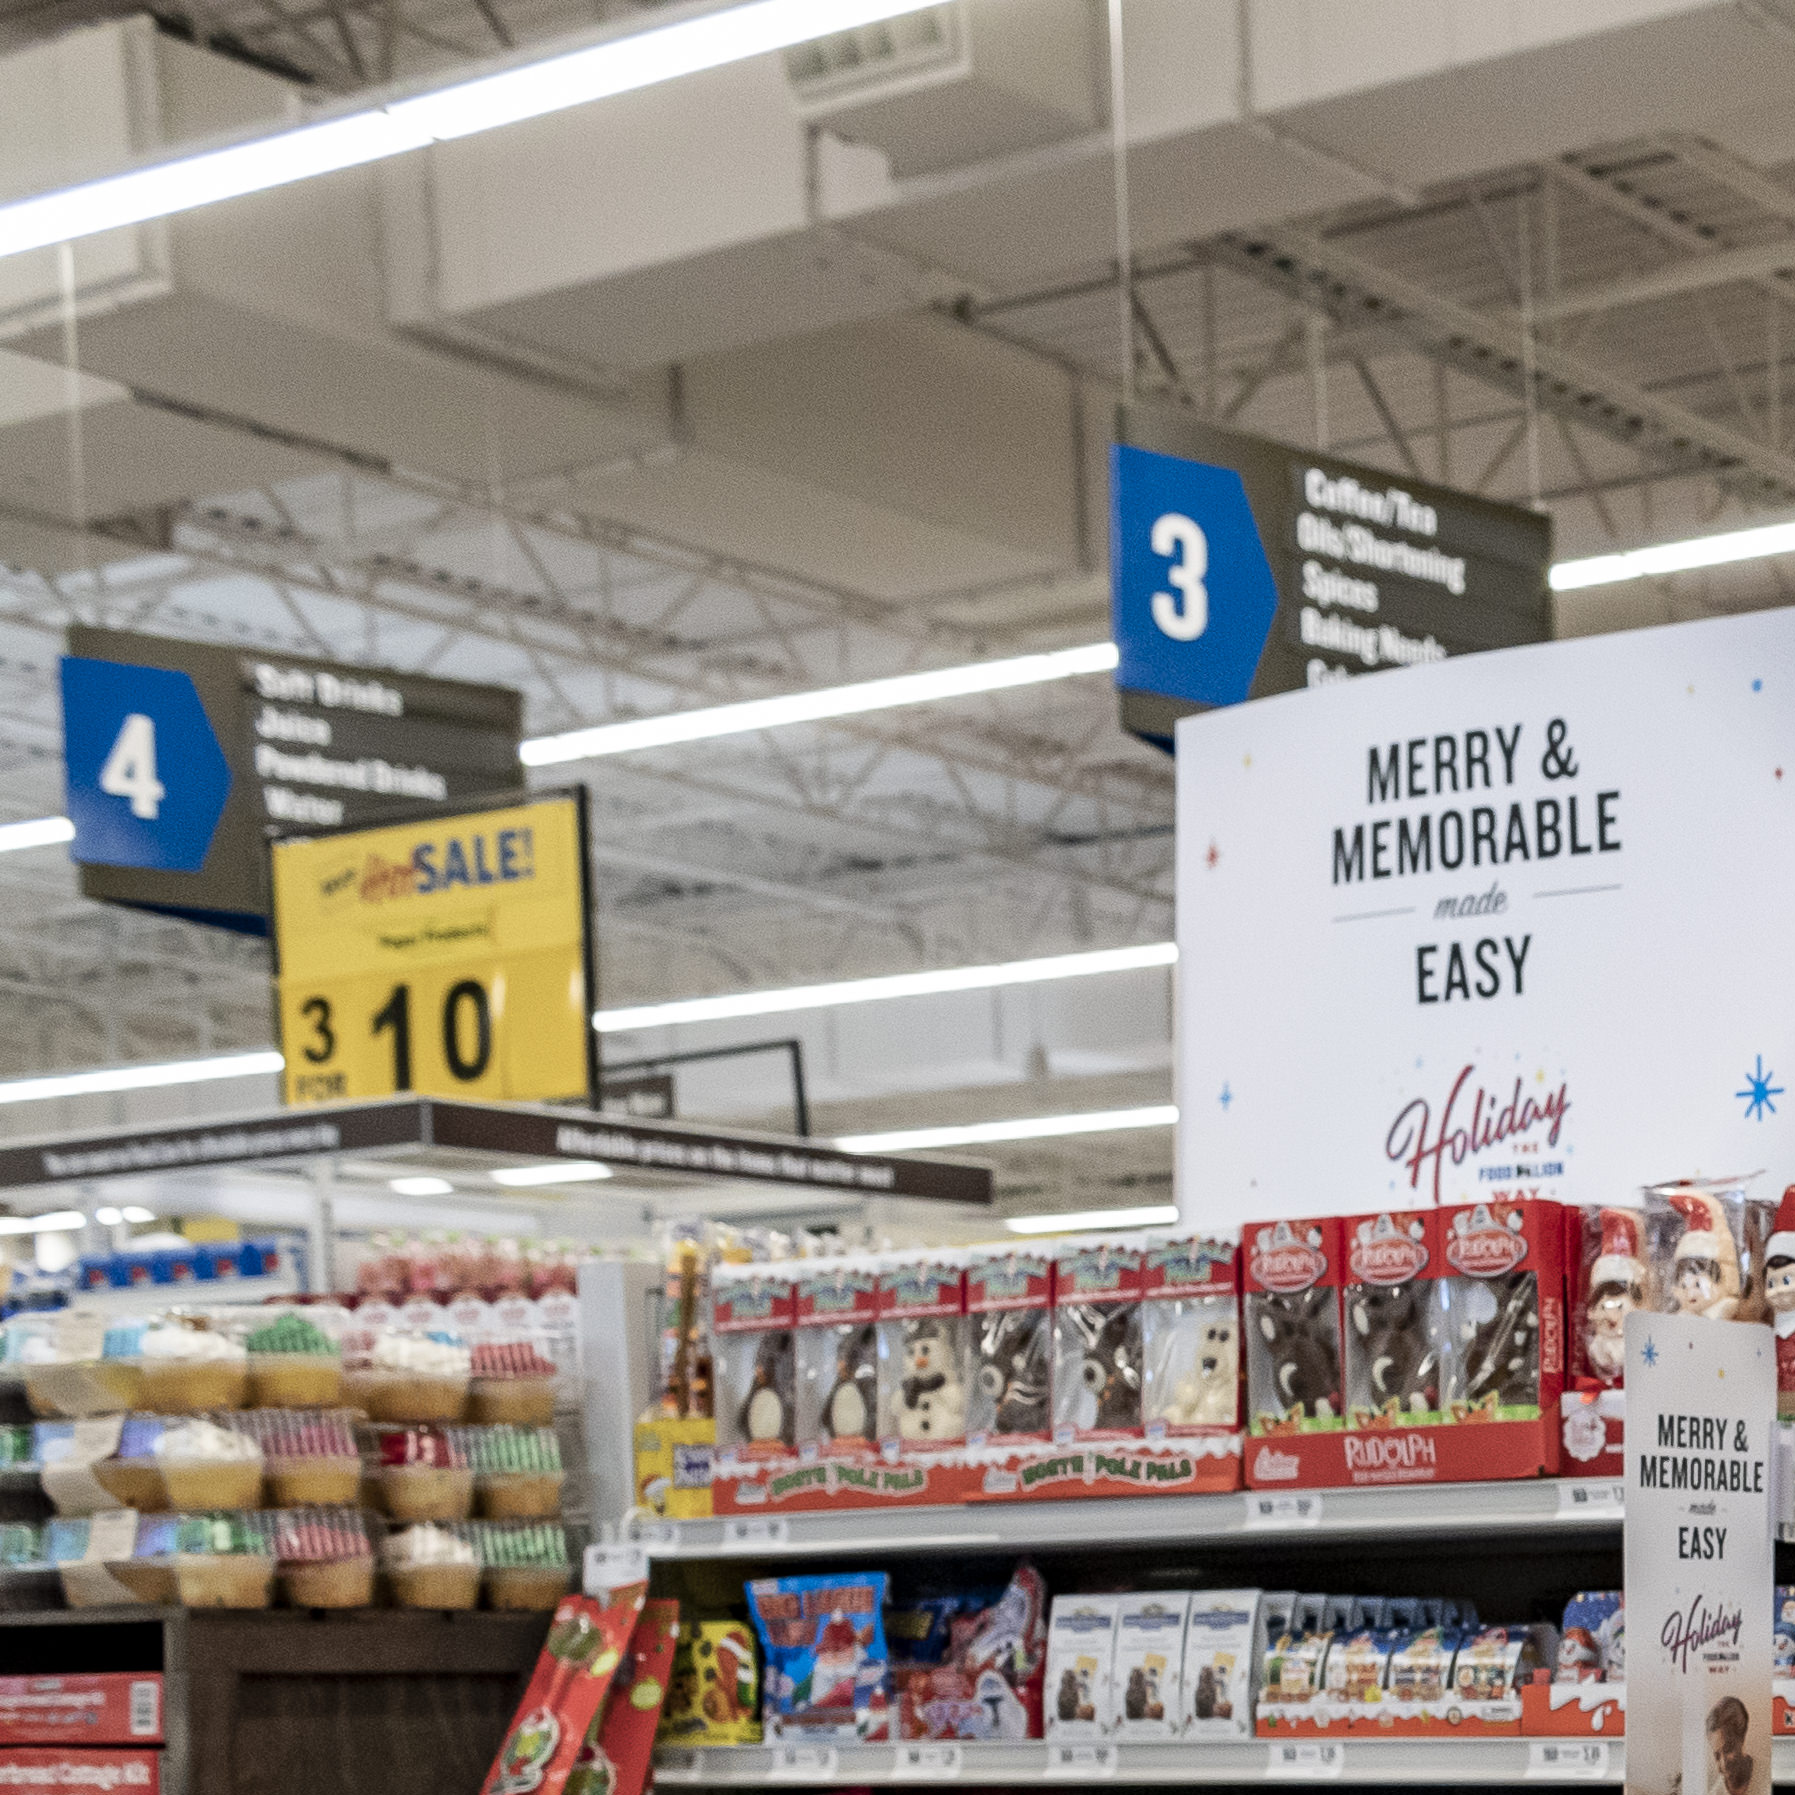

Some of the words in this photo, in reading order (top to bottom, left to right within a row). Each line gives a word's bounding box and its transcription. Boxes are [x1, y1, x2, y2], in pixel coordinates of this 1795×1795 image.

[1151, 512, 1208, 642] 3
[100, 713, 164, 819] 4
[1367, 724, 1522, 804] MERRY
[1541, 718, 1579, 780] &
[413, 828, 533, 894] SALE!
[1333, 791, 1622, 884] MEMORABLE
[1434, 882, 1508, 920] made
[1417, 935, 1532, 1004] EASY
[302, 995, 335, 1064] 3
[371, 978, 493, 1093] 10
[1385, 1065, 1571, 1204] Holiday
[1658, 1413, 1728, 1451] MERRY
[1733, 1416, 1749, 1452] &
[1640, 1455, 1764, 1494] MEMORABLE
[1678, 1527, 1728, 1560] EASY
[1660, 1596, 1744, 1674] Holiday
